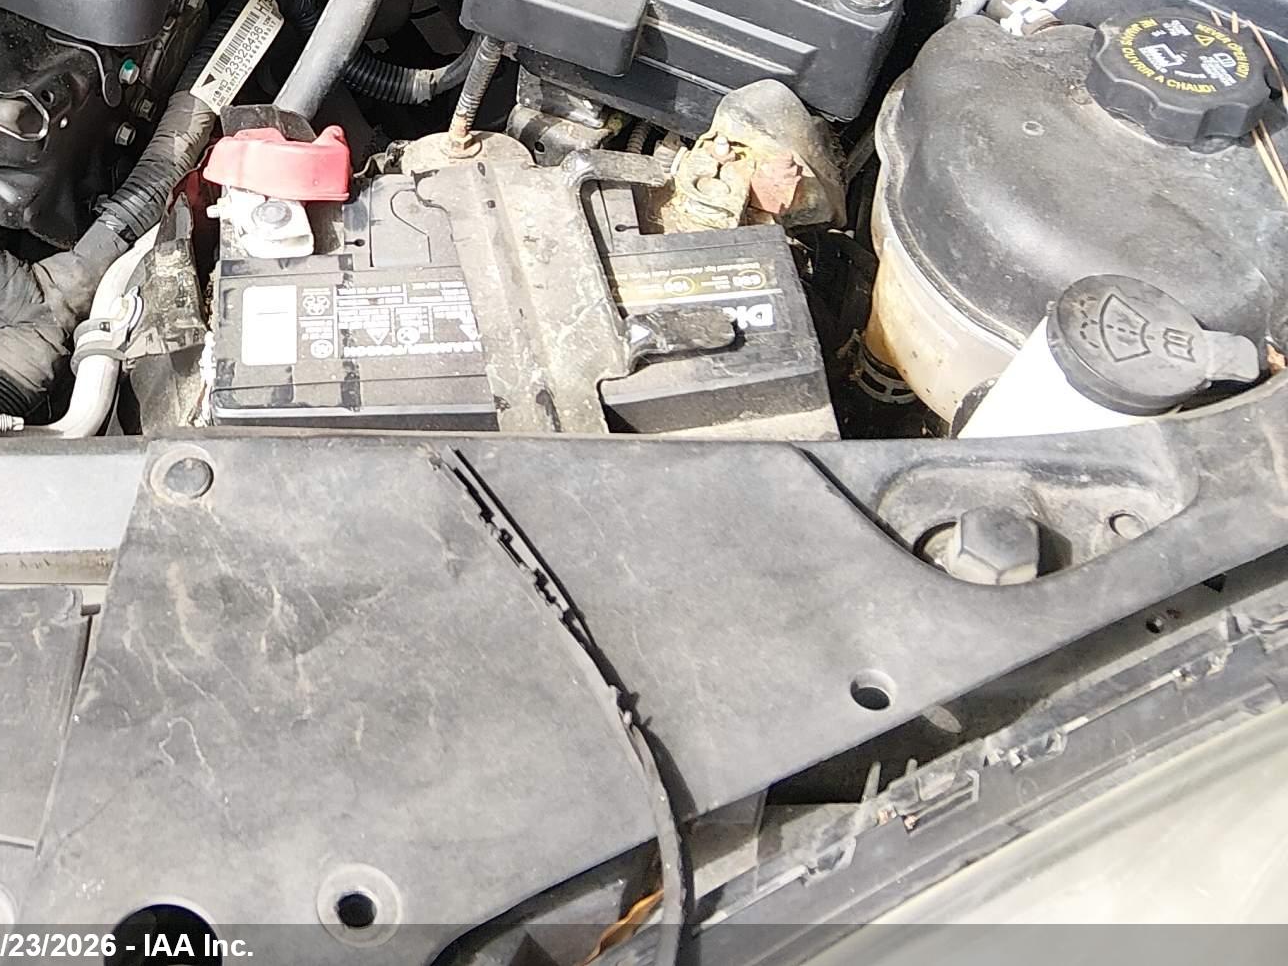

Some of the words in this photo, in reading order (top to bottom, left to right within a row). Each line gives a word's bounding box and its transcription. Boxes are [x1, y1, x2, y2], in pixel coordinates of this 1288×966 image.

[225, 26, 264, 77] 23328436
[1121, 47, 1156, 78] OUVRIR
[1166, 78, 1217, 94] CHAUD!
